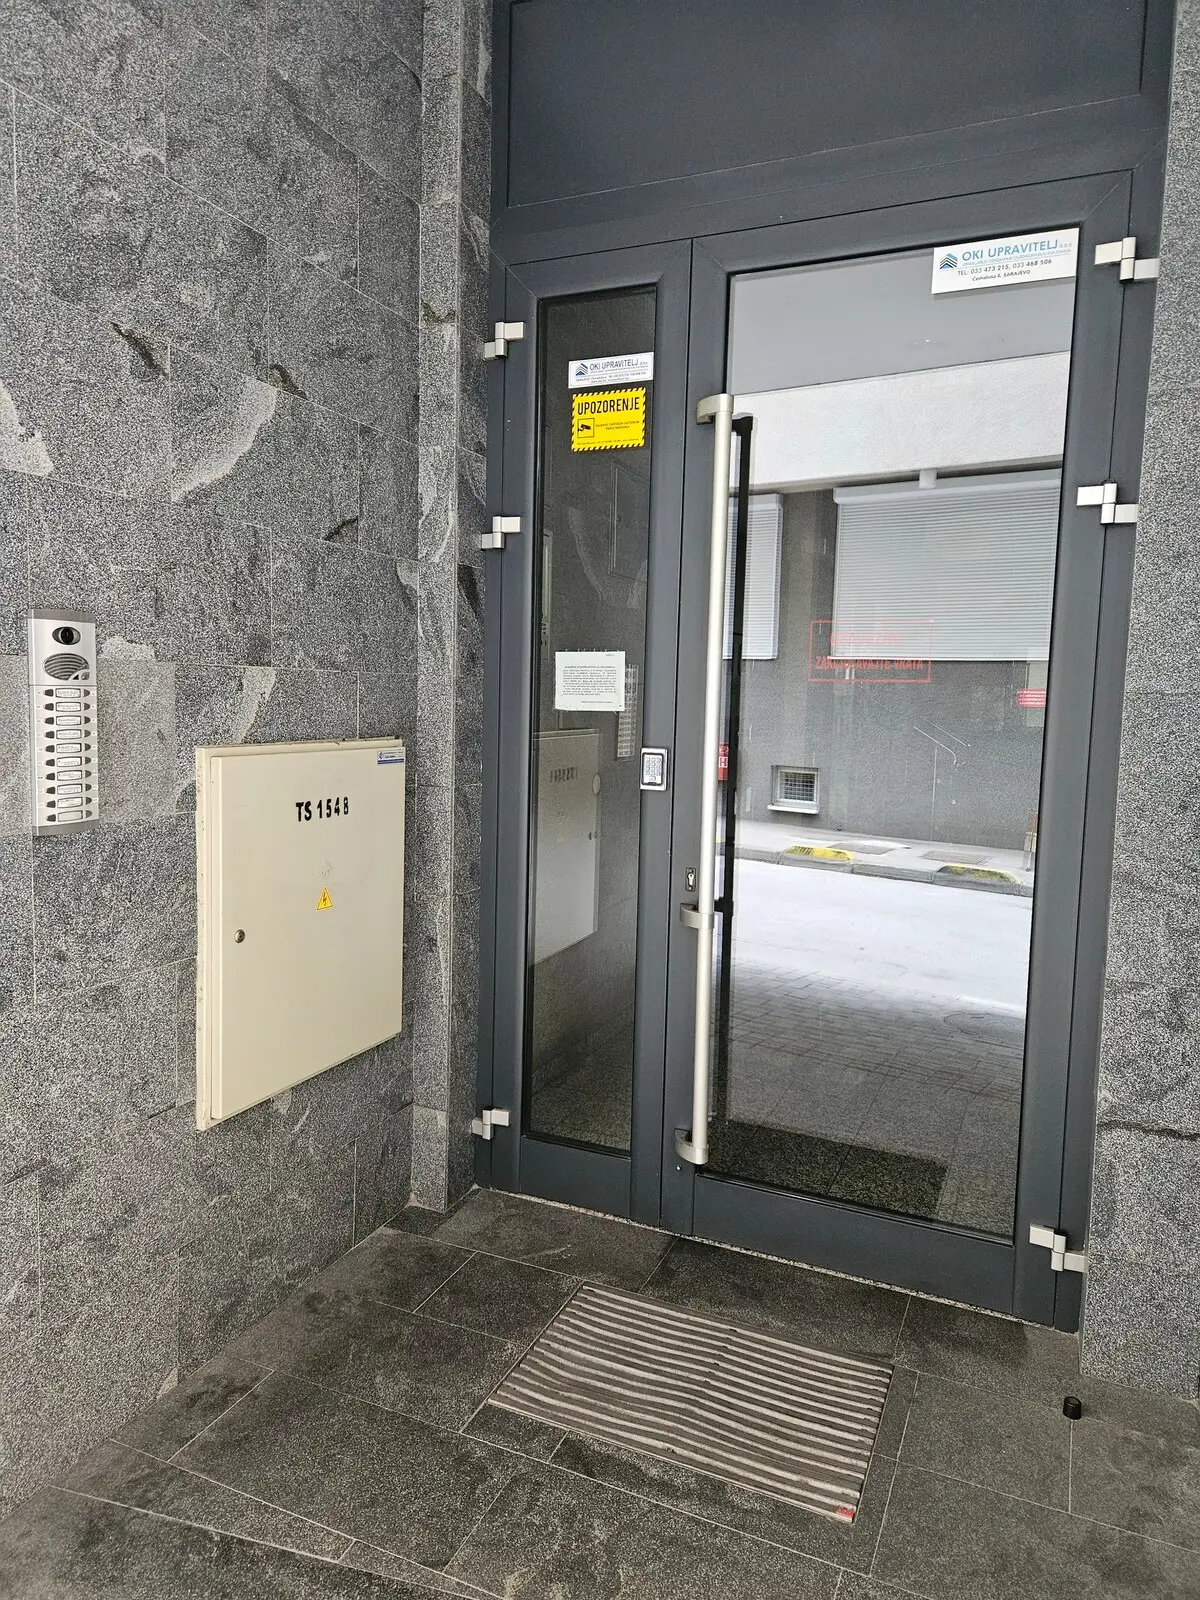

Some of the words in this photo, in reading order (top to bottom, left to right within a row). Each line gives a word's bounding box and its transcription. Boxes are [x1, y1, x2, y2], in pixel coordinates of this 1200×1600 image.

[962, 250, 984, 261] OKI
[987, 239, 1058, 258] UPRAVITELJ
[970, 267, 982, 275] 033
[984, 265, 996, 273] 473
[1012, 261, 1024, 269] 033
[1003, 269, 1031, 277] SARAJEVO
[589, 363, 601, 371] OKI
[602, 358, 639, 370] UPRAVITELJ
[578, 396, 640, 415] UPOZORENJE
[296, 800, 312, 822] TS
[317, 796, 349, 819] 1548
